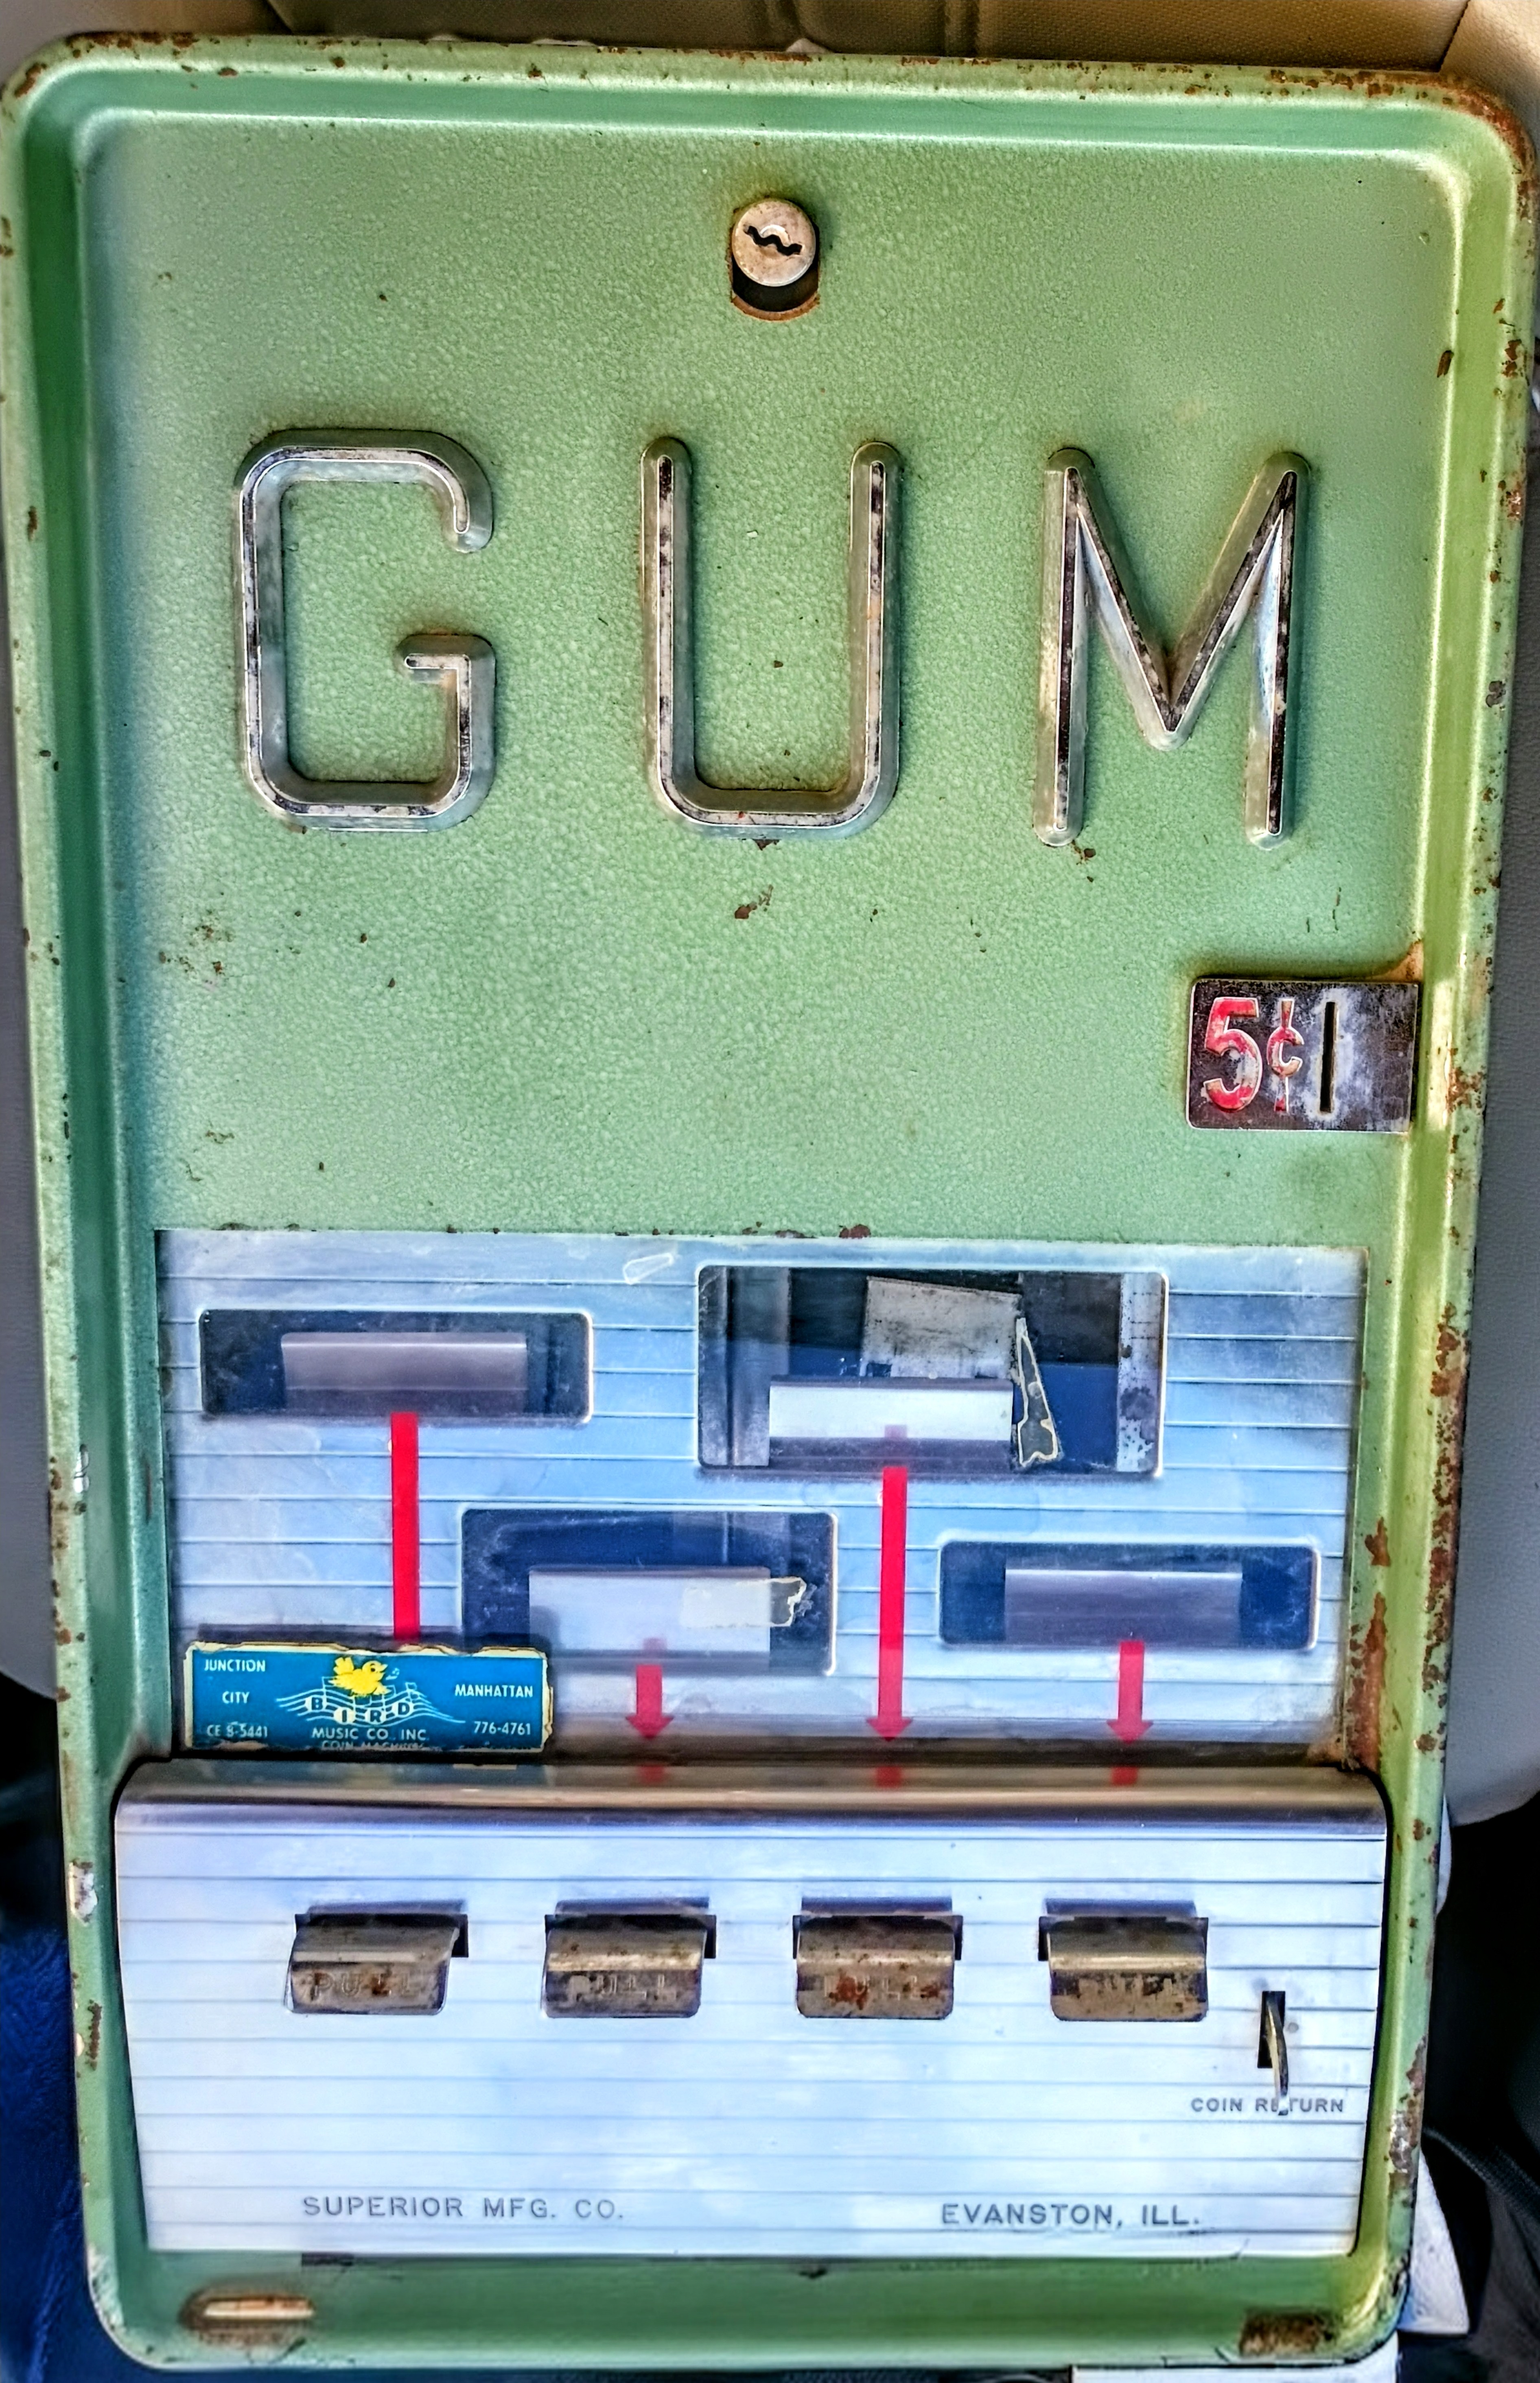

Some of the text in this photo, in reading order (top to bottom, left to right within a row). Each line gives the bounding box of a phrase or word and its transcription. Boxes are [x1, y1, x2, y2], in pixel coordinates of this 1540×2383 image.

[234, 428, 1312, 849] GUM
[1203, 997, 1304, 1114] 5¢
[204, 1659, 266, 1672] JUNCTION
[222, 1691, 250, 1704] CITY
[454, 1684, 534, 1698] MANHATTAN
[308, 1696, 412, 1724] BIRD
[207, 1724, 221, 1737] CE
[311, 1727, 359, 1740] MUSIC
[474, 1721, 531, 1735] 776-4761
[1191, 2097, 1242, 2112] COIN
[303, 2196, 624, 2219] SUPERIOR MFG. CO.
[942, 2203, 1200, 2229] EVANSTON, ILL.
